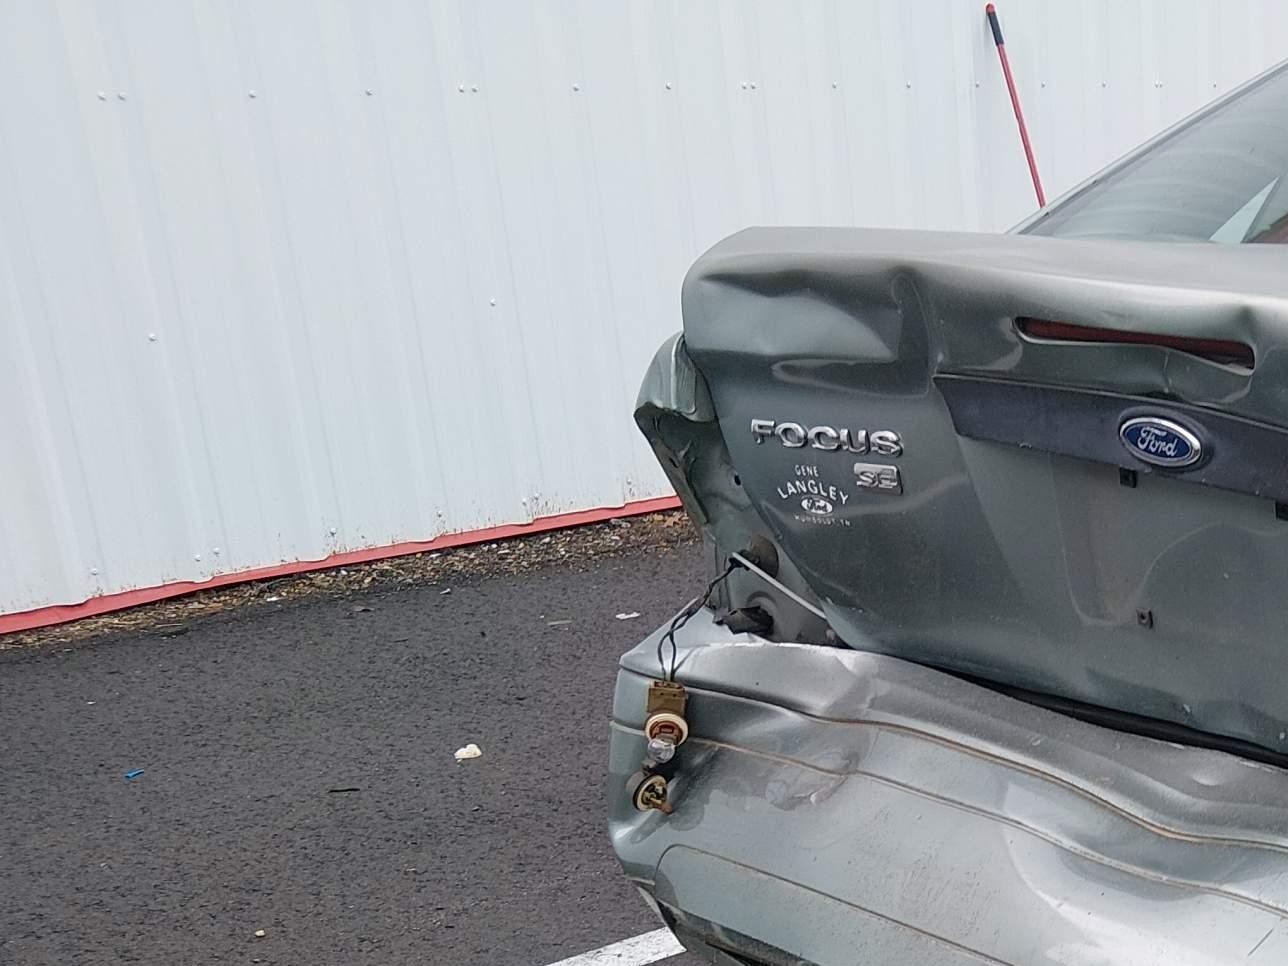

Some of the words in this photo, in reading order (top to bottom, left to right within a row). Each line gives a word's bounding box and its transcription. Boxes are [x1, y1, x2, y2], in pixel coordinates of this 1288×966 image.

[751, 418, 903, 457] FOCUS
[1137, 426, 1178, 457] Ford
[794, 464, 819, 477] GENE
[777, 479, 849, 505] LANGLEY
